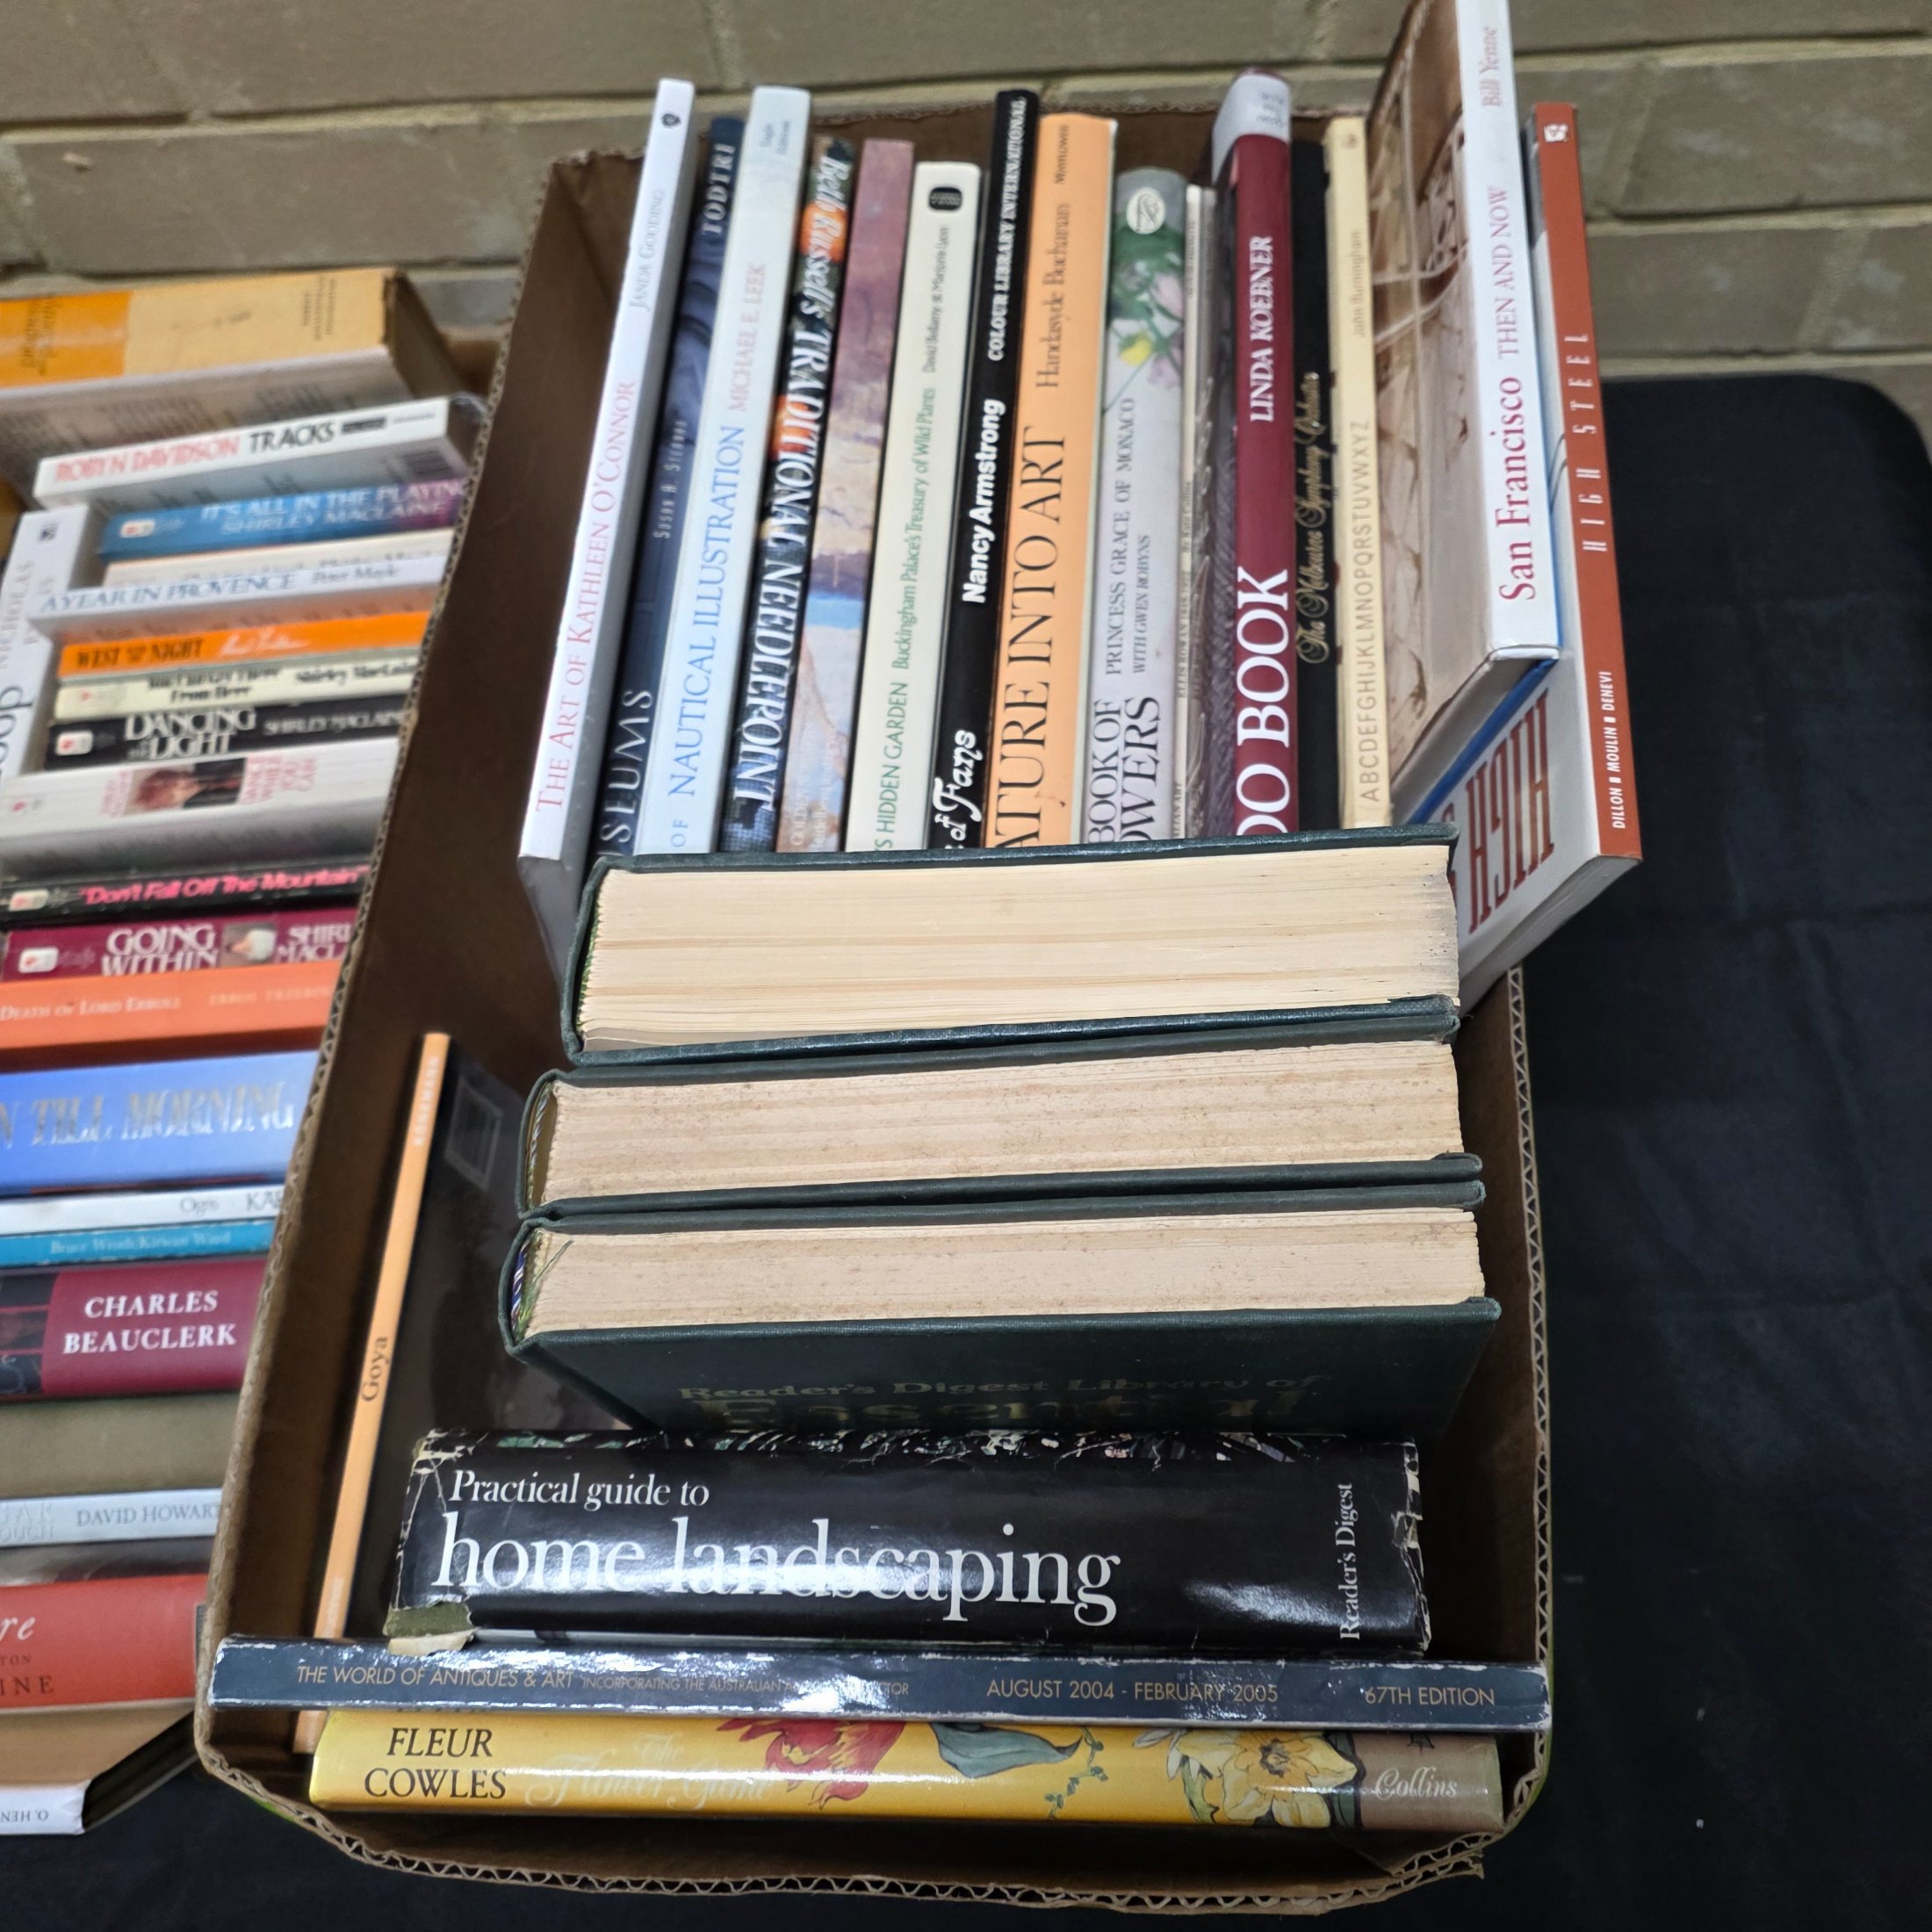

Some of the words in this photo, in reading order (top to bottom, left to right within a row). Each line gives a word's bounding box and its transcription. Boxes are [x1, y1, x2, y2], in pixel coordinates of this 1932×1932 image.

[701, 141, 737, 236] TODTRI
[818, 156, 850, 211] Beth
[999, 97, 1027, 220] INTERNATIONAL
[1487, 184, 1510, 235] NOW
[800, 209, 846, 320] Russell's
[994, 222, 1015, 292] LIBRARY
[1042, 202, 1071, 286] Buchanan
[1491, 237, 1514, 290] AND
[1249, 235, 1274, 342] KOEBNER
[727, 323, 759, 413] MICHAEL
[743, 263, 767, 306] LEEK
[987, 293, 1008, 362] COLOUR
[1492, 296, 1521, 361] THEN
[918, 387, 937, 424] Plants
[1249, 348, 1274, 423] LINDA
[1563, 333, 1599, 437] STEEL
[249, 421, 335, 454] TRACKS
[590, 380, 637, 514] O'CONNOR
[764, 329, 832, 548] TRADITIONAL
[915, 458, 928, 475] of
[974, 399, 1007, 527] Armstrong
[1116, 397, 1136, 473] MONACO
[1488, 376, 1533, 529] Francisco
[905, 475, 932, 532] Treasury
[1019, 424, 1066, 525] ART
[1116, 480, 1134, 503] OF
[693, 425, 745, 628] ILLUSTRATION
[1111, 508, 1131, 577] GRACE
[1575, 466, 1609, 553] HIGH
[566, 522, 611, 645] KATHLEEN
[900, 529, 922, 583] Palace's
[962, 531, 996, 604] Nancy
[1294, 530, 1330, 619] Melbourne
[1498, 541, 1537, 602] San
[61, 590, 126, 610] YEAR
[132, 588, 159, 606] IN
[166, 573, 299, 600] PROVENCE
[1007, 535, 1060, 668] INTO
[1349, 419, 1381, 803] ABCDEFGHIJKLMNOPQRSTUVWXYZ
[892, 583, 919, 670] Buckingham
[1105, 582, 1126, 676] PRINCESS
[1236, 566, 1290, 749] BOOK
[1294, 620, 1330, 665] The
[564, 653, 588, 687] OF
[732, 559, 804, 811] NEEDLEPOINT
[1597, 670, 1616, 711] DENEVI
[124, 708, 257, 742] DANCING
[548, 694, 581, 750] ART
[667, 635, 718, 798] NAUTICAL
[883, 681, 909, 761] GARDEN
[1093, 697, 1122, 744] OF
[1603, 725, 1621, 773] MOULIN
[535, 758, 572, 812] THE
[597, 688, 654, 856] SEUMS
[876, 764, 900, 834] HIDDEN
[932, 729, 984, 823] Fans
[1087, 747, 1120, 844] BOOK
[670, 818, 689, 849] OF
[934, 813, 967, 841] of
[1609, 787, 1626, 830] DILLON
[143, 879, 183, 901] Fall
[182, 876, 220, 898] Off
[221, 873, 261, 894] The
[100, 948, 220, 977] WITHIN
[105, 923, 217, 956] GOING
[83, 1289, 220, 1319] CHARLES
[61, 1323, 239, 1355] BEAUCLERK
[360, 1336, 389, 1403] Goya
[76, 1506, 138, 1527] DAVID
[448, 1469, 579, 1505] Practical
[583, 1474, 672, 1512] guide
[680, 1481, 710, 1507] to
[1334, 1481, 1360, 1547] Digest
[430, 1510, 646, 1594] home
[669, 1516, 1121, 1627] landscaping
[1339, 1551, 1360, 1641] Reader's
[296, 1665, 328, 1684] THE
[333, 1666, 396, 1685] WORLD
[400, 1667, 425, 1686] OF
[429, 1668, 518, 1688] ANTIQUES
[523, 1669, 537, 1688] &
[541, 1670, 575, 1690] ART
[581, 1673, 681, 1693] INCORPORATING
[684, 1676, 706, 1693] THE
[709, 1677, 782, 1694] AUSTRALIAN
[986, 1679, 1062, 1700] AUGUST
[1070, 1681, 1115, 1701] 2004
[1134, 1682, 1226, 1704] FEBRUARY
[1232, 1684, 1279, 1704] 2005
[1364, 1686, 1411, 1706] 67TH
[1417, 1687, 1496, 1707] EDITION
[386, 1727, 494, 1758] FLEUR
[364, 1767, 508, 1800] COWLES
[1371, 1767, 1460, 1803] Collins
